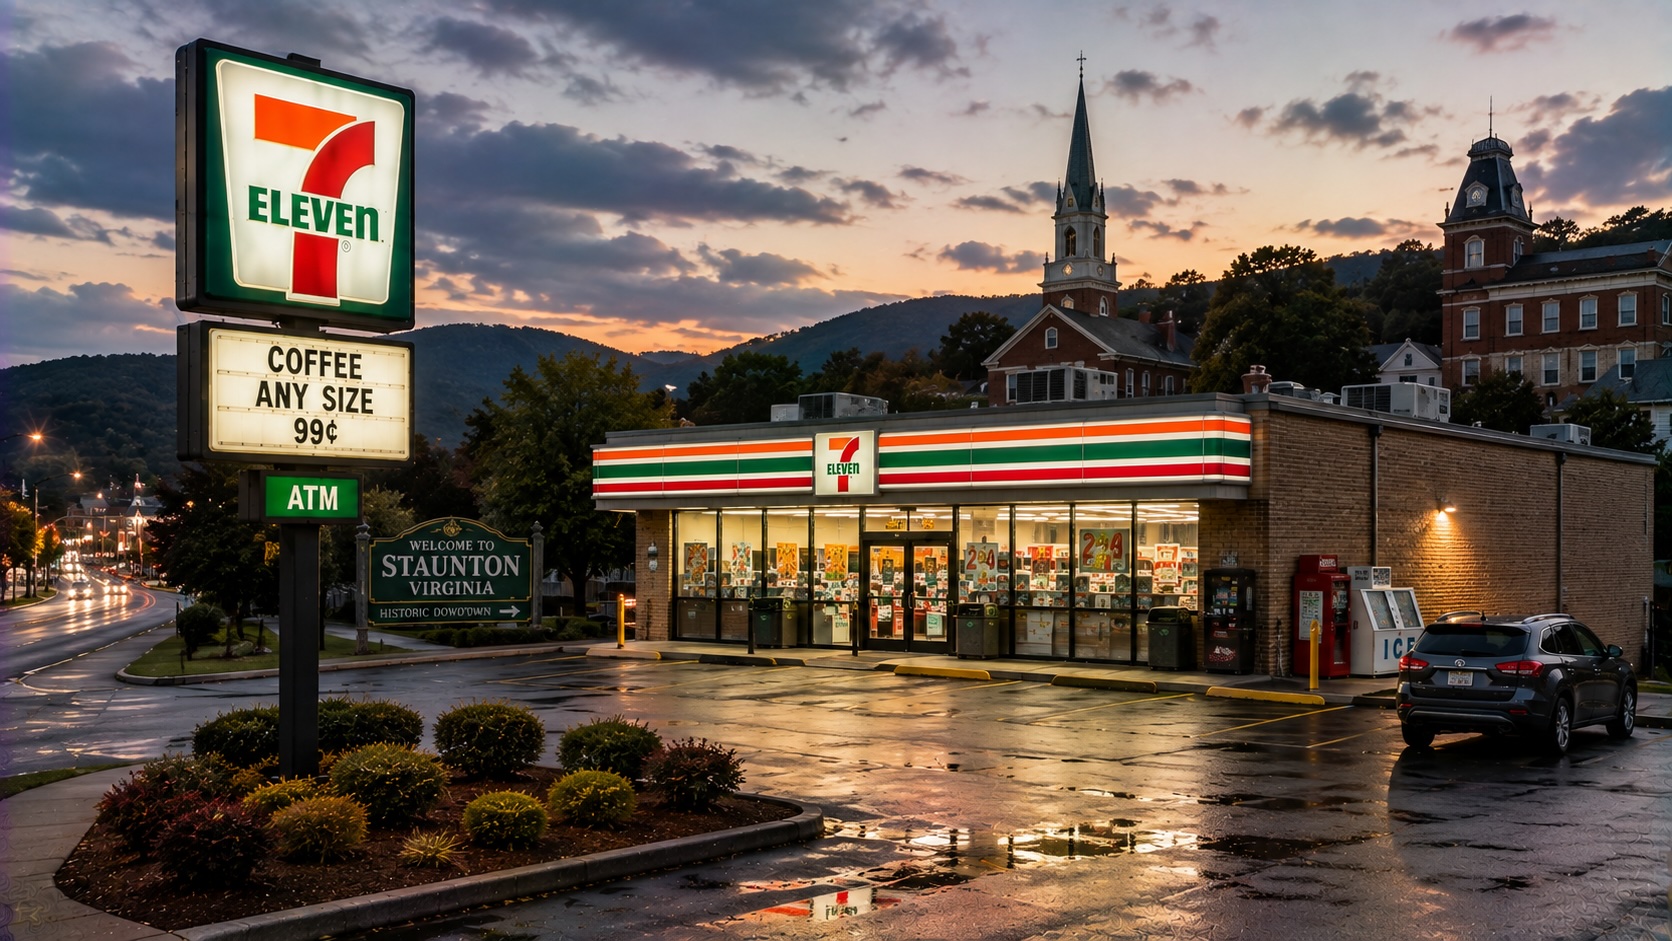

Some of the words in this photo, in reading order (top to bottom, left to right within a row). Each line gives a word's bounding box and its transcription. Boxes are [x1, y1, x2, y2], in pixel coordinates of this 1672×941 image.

[254, 93, 375, 299] 7
[267, 345, 362, 380] COFFEE
[255, 380, 309, 410] ANY
[322, 385, 374, 415] SIZE
[293, 417, 338, 445] 99¢
[828, 436, 859, 492] 7
[286, 484, 338, 511] ATM
[409, 540, 473, 551] WELCOME
[477, 540, 495, 551] TO
[381, 554, 521, 578] STAUNTON
[408, 580, 495, 596] VIRGINIA
[379, 607, 429, 619] HISTORIC
